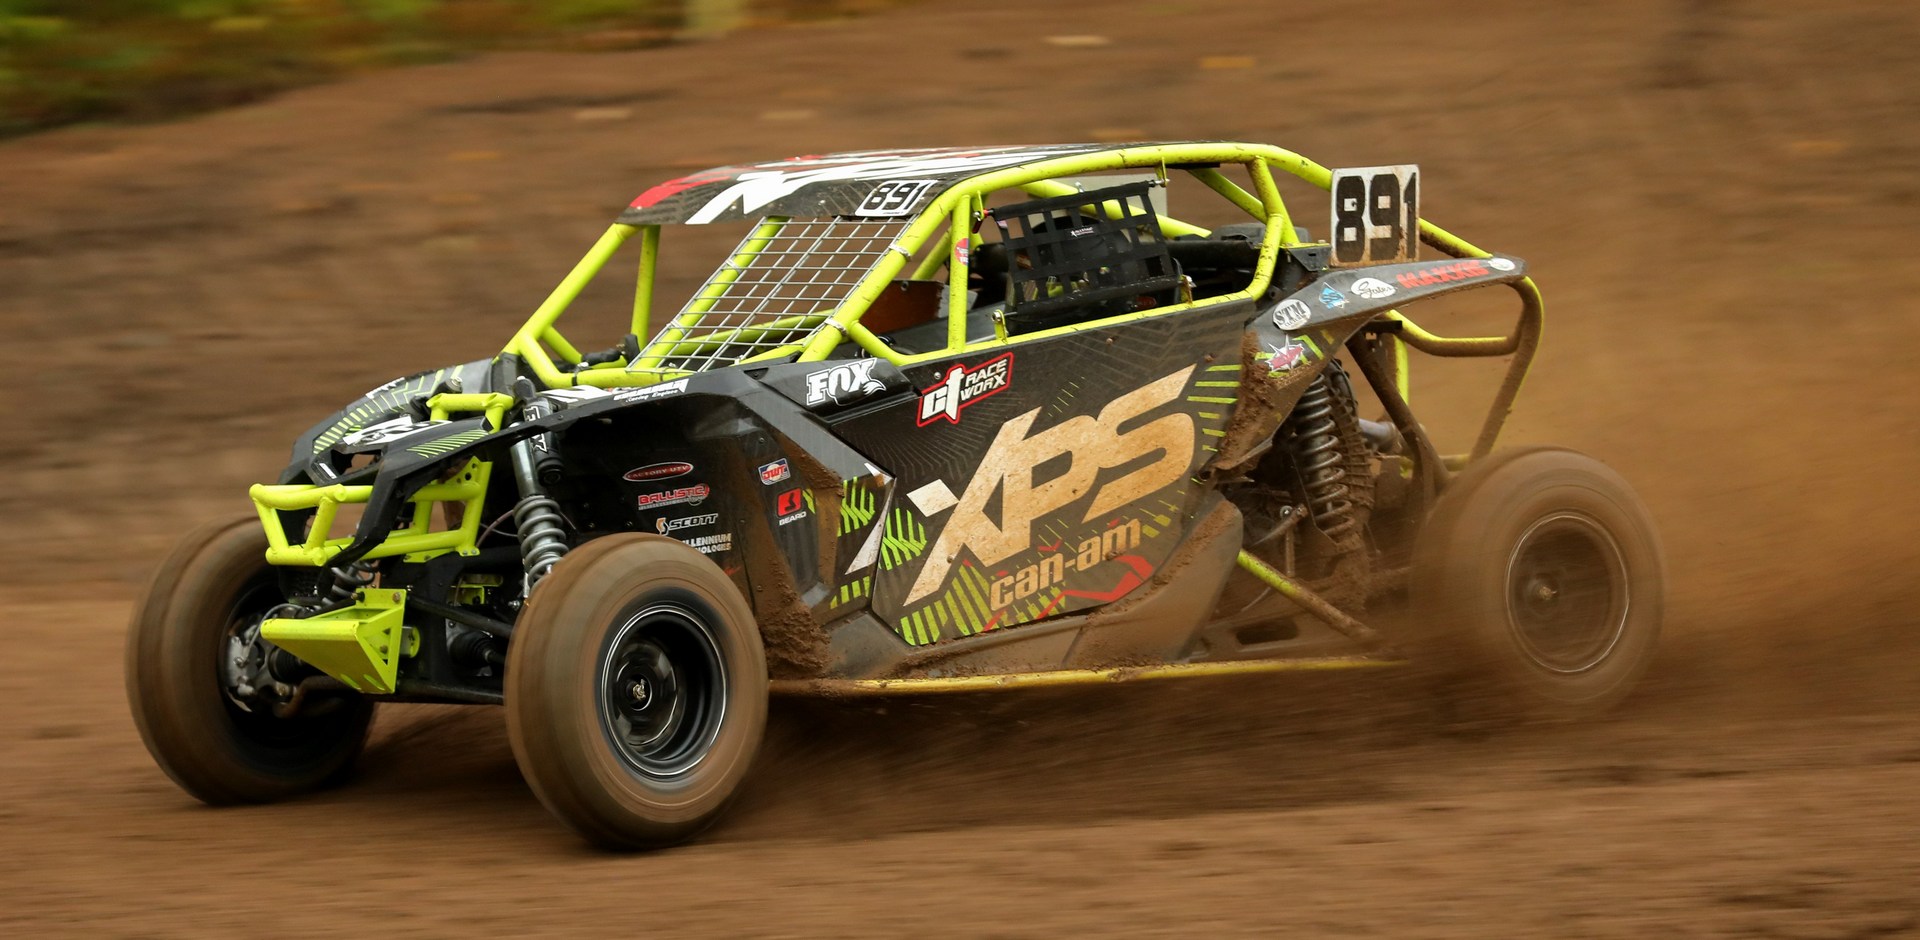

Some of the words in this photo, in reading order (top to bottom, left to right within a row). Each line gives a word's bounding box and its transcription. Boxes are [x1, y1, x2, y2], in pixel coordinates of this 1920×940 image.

[863, 181, 933, 211] 891
[1336, 172, 1416, 262] 891
[1396, 260, 1489, 289] MAXXIS
[1275, 301, 1306, 325] STM
[806, 358, 887, 406] FOX
[960, 371, 1006, 400] WORX
[965, 359, 1007, 387] RACE
[523, 405, 548, 452] FX
[626, 468, 667, 479] FACTORY
[762, 465, 786, 480] DWT
[903, 363, 1197, 606] XPS
[638, 485, 706, 506] BALLISTIC
[667, 513, 718, 531] SCOTT
[779, 511, 807, 526] BEARD
[990, 518, 1142, 612] can-am
